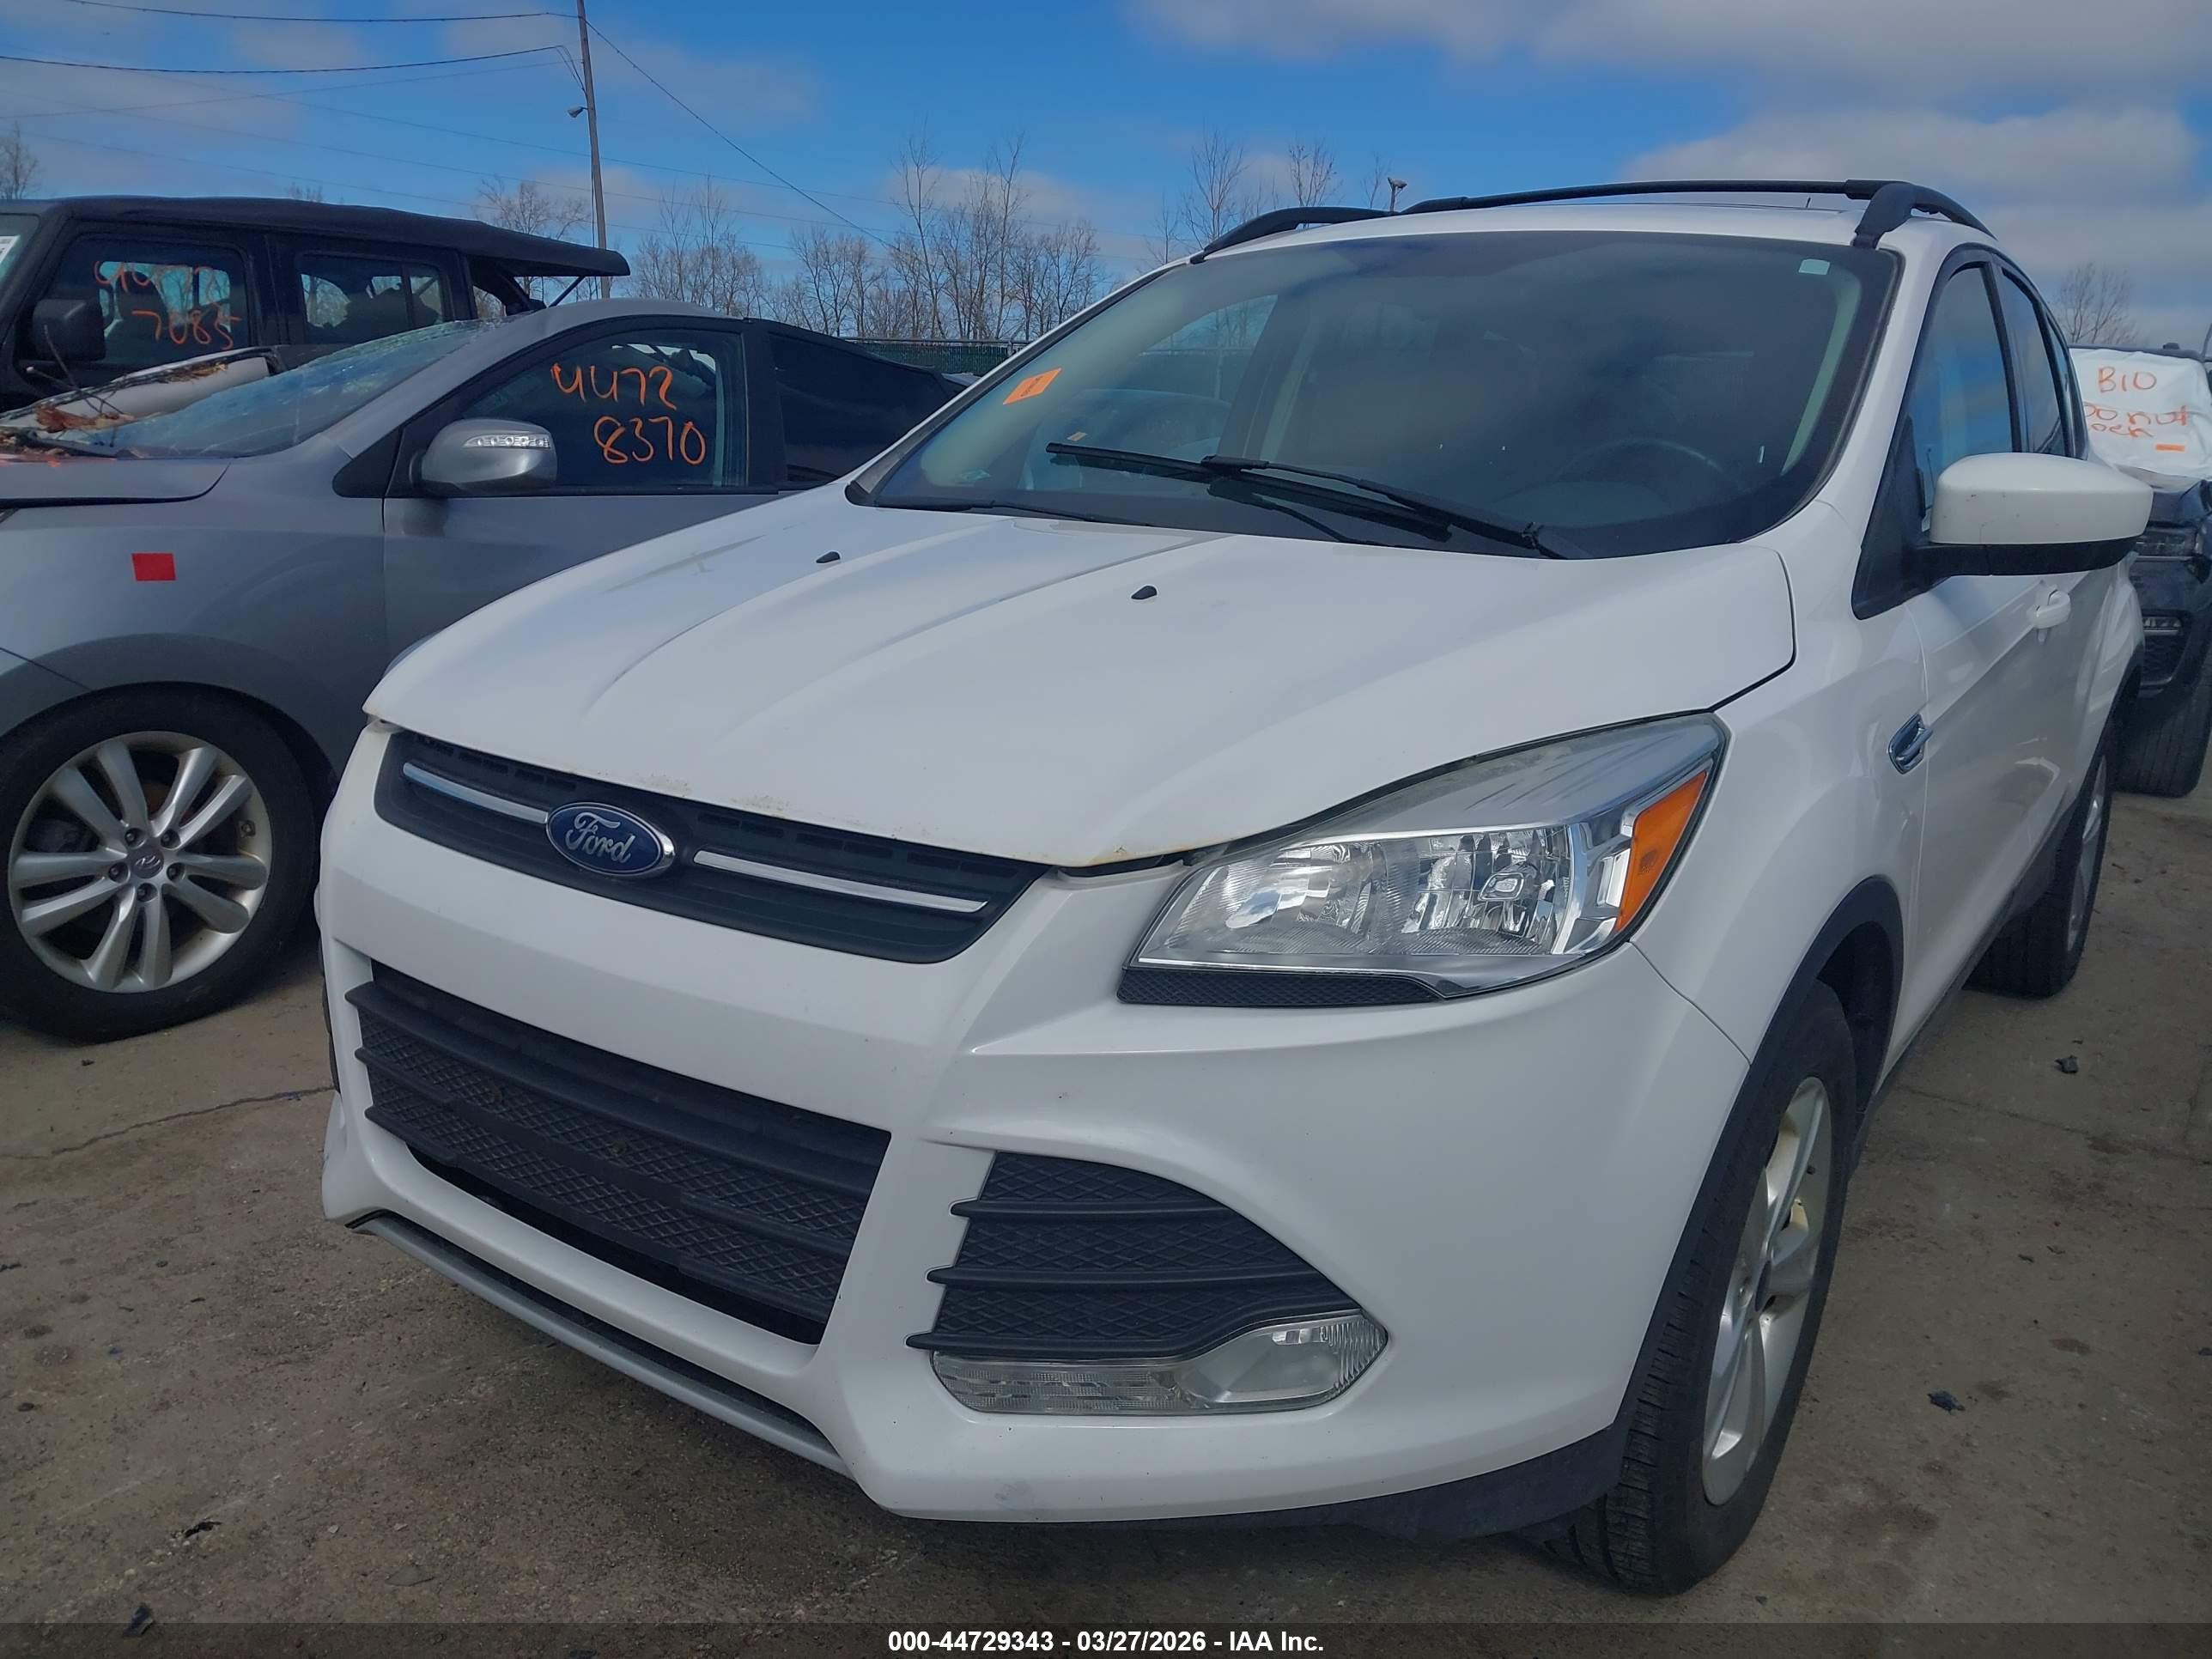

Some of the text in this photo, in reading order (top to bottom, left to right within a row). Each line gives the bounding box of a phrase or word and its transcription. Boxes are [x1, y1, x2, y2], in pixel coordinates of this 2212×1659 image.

[551, 362, 677, 410] 4472
[594, 416, 706, 465] 8370
[565, 811, 636, 864] Ford
